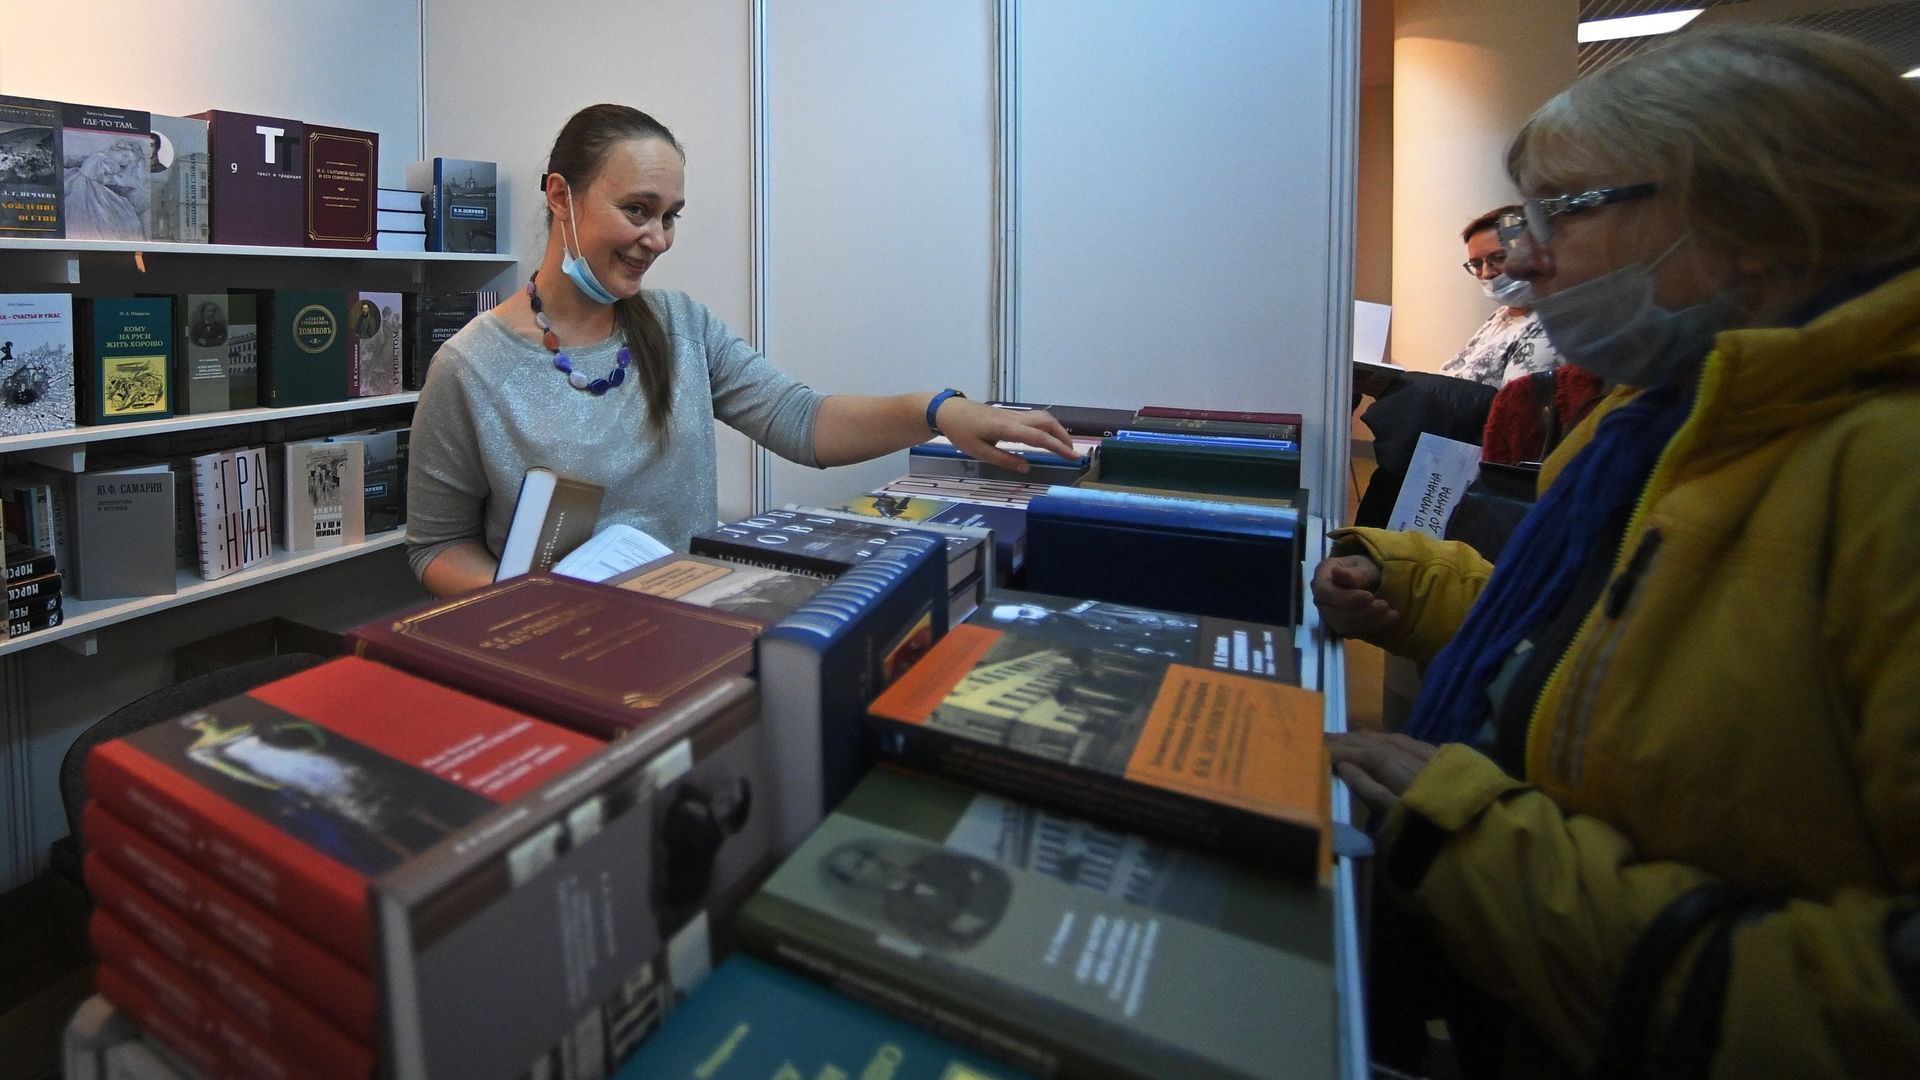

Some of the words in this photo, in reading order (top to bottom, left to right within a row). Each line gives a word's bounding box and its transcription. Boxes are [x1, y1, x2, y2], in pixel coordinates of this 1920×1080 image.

[82, 117, 112, 128] ГДЕ-ТО
[230, 162, 238, 174] 9
[123, 325, 146, 333] КОМУ
[119, 333, 131, 341] НА
[132, 333, 151, 341] РУСИ
[105, 341, 129, 349] ЖИТЬ
[129, 340, 164, 348] ХОРОШО
[120, 482, 163, 494] САМАРИН
[1418, 472, 1442, 515] МУРМАНА
[1427, 517, 1443, 534] ДО
[1437, 486, 1453, 517] АМУРА
[315, 520, 341, 530] ДУШИ
[1415, 515, 1424, 528] ОТ
[315, 528, 341, 538] ЖИВЫЕ
